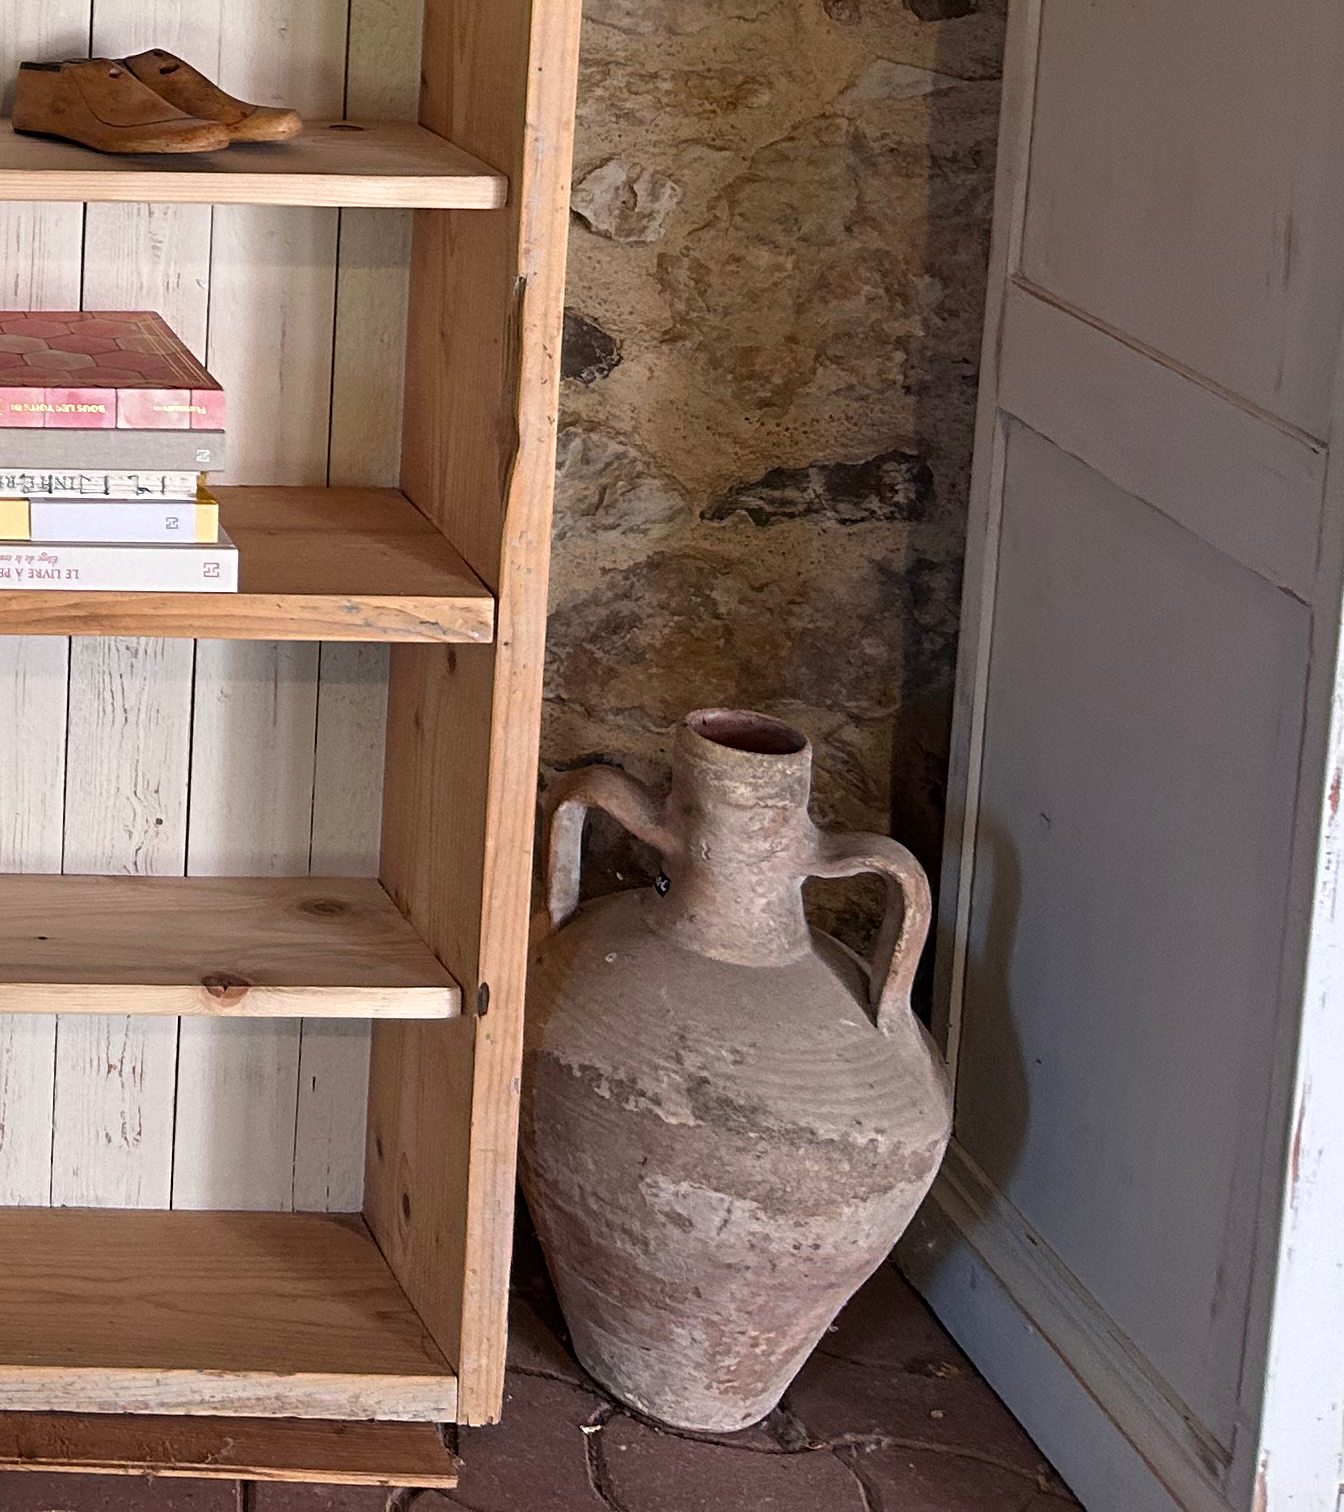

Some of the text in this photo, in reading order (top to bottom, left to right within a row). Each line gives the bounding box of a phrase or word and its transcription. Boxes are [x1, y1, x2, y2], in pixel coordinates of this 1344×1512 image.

[14, 567, 23, 582] À
[27, 567, 61, 580] LIVRE
[65, 567, 79, 579] LE
